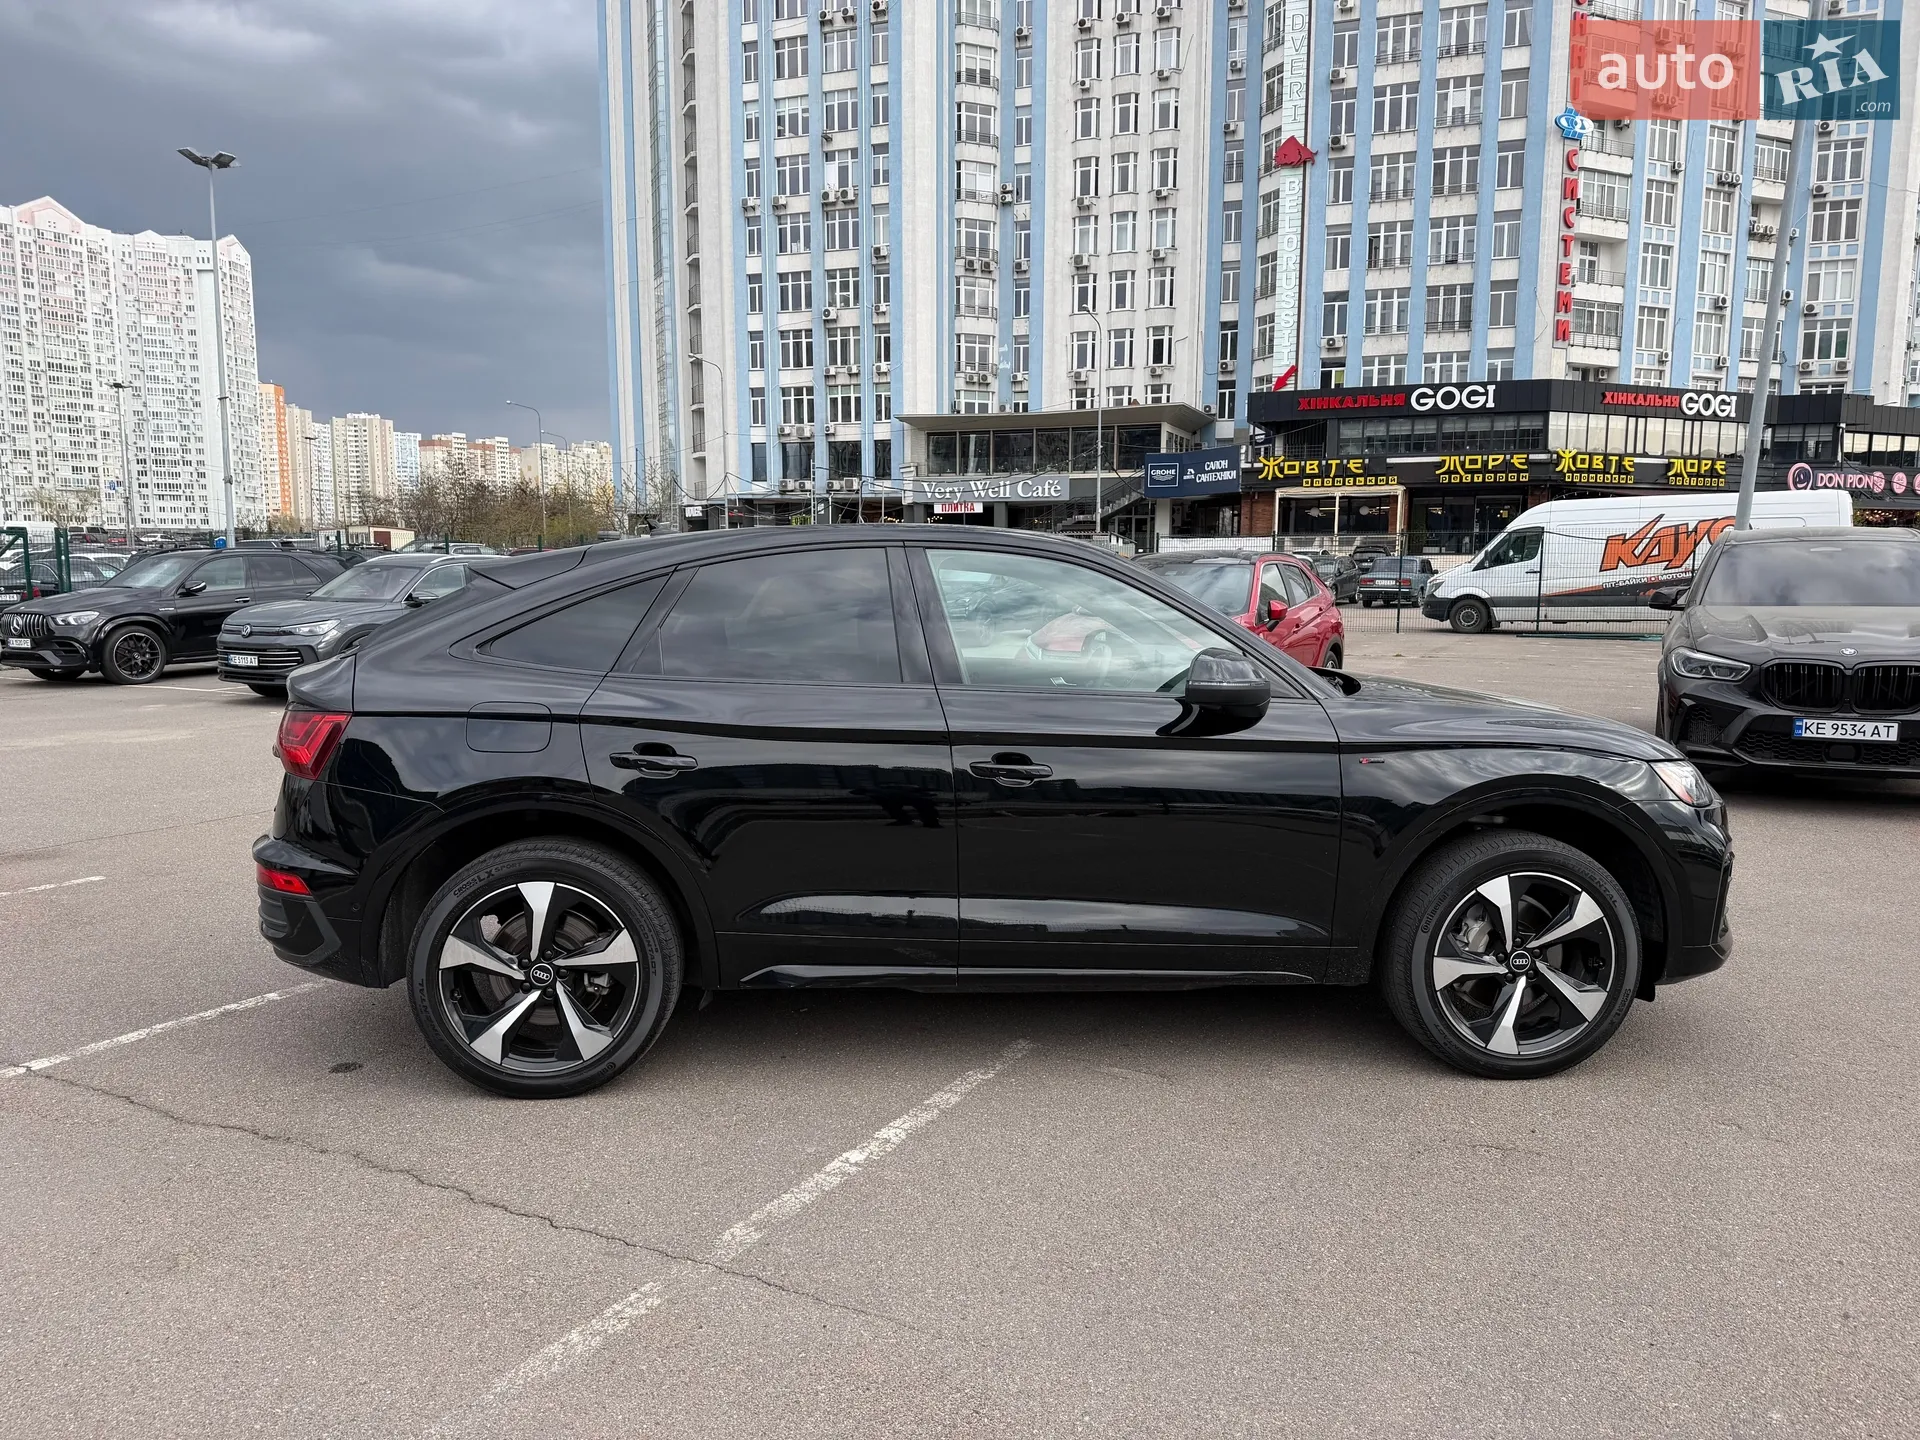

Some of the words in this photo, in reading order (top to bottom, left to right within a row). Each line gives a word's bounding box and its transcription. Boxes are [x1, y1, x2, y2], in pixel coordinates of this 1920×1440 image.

[1570, 0, 1588, 101] ННІ
[1289, 13, 1307, 122] DVERI
[1556, 149, 1579, 342] СИСТЕМИ
[1298, 393, 1406, 411] ХІНКАЛЬНЯ
[1410, 384, 1496, 411] GOGI
[1603, 391, 1680, 408] ХІНКАЛЬНЯ
[1681, 392, 1738, 418] GOGI
[1151, 468, 1176, 476] GROHE
[1205, 459, 1229, 471] САЛОН
[1258, 455, 1364, 480] ЖОВТЕ
[1555, 448, 1635, 473] ЖОВТЕ
[1196, 470, 1237, 483] САНТЕХНІКИ
[1816, 472, 1844, 488] DON
[921, 481, 965, 503] Very
[969, 480, 1010, 498] Well
[1017, 479, 1061, 498] Café
[941, 502, 976, 513] ПЛИТКА
[249, 657, 257, 665] AT
[1804, 721, 1827, 735] KE
[1831, 723, 1866, 737] 9534
[1870, 725, 1895, 738] AT
